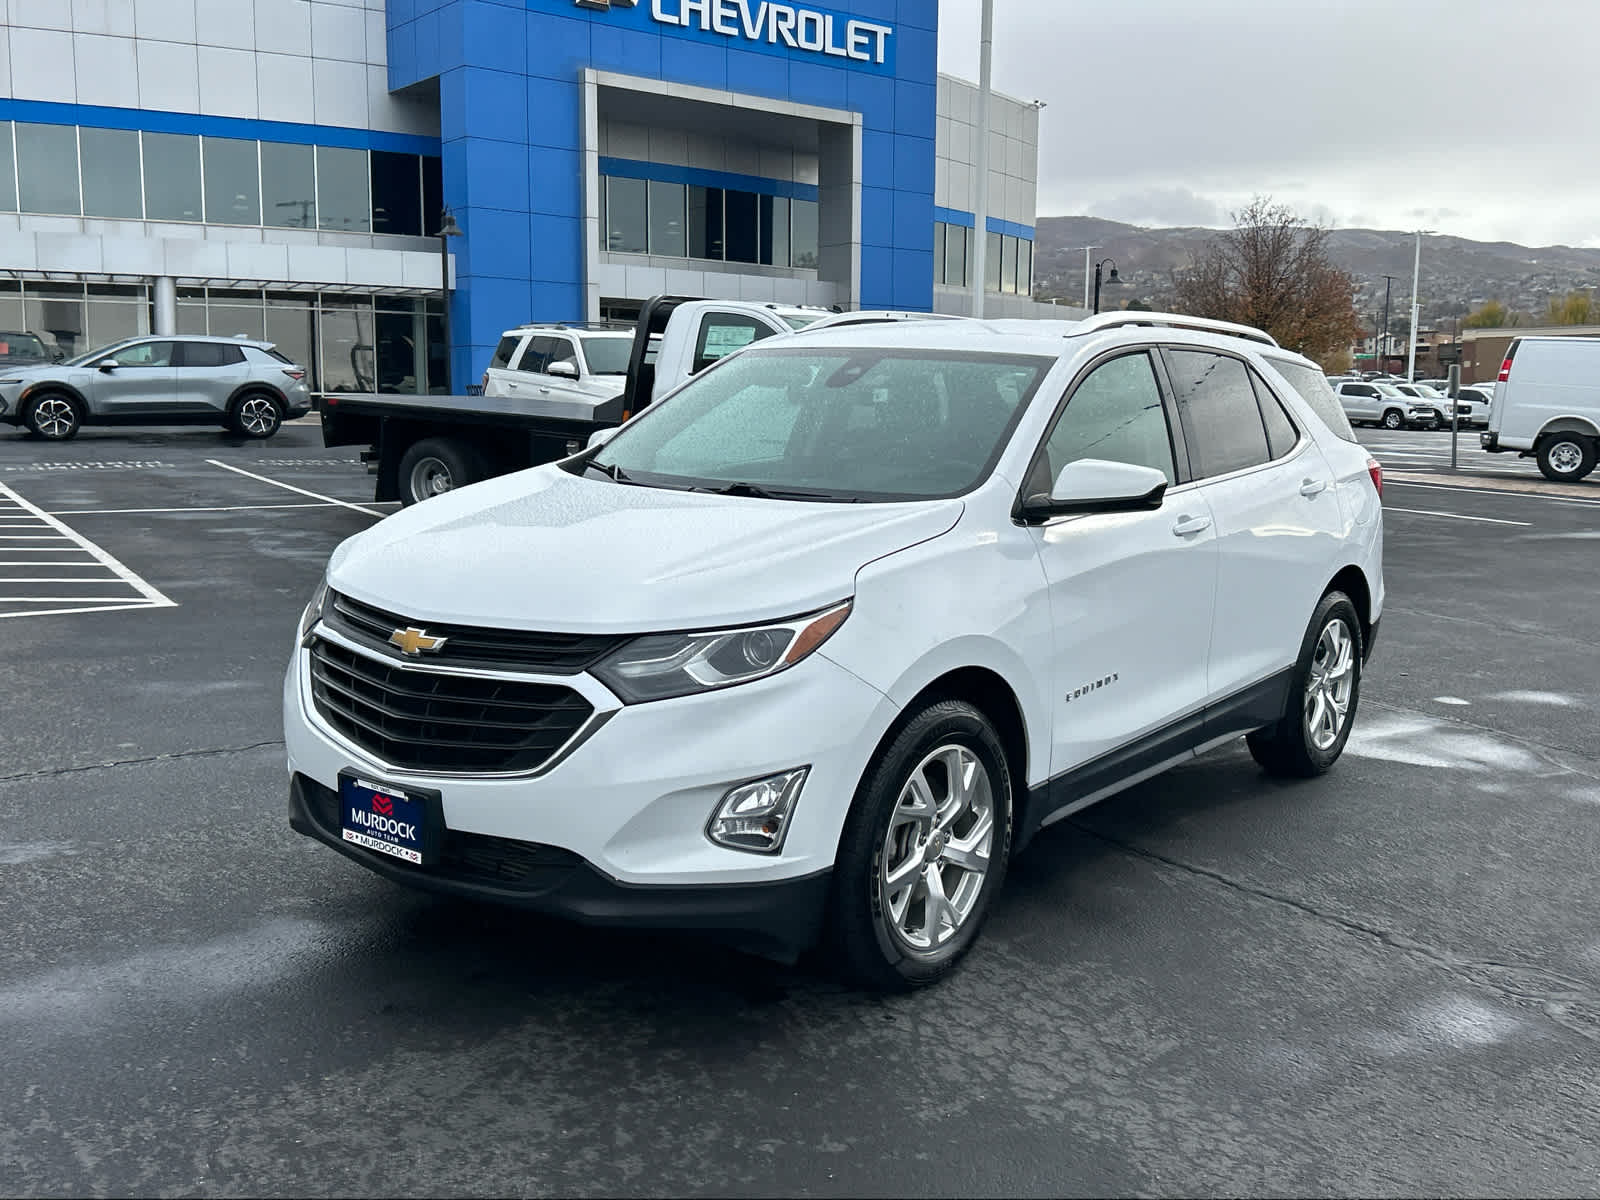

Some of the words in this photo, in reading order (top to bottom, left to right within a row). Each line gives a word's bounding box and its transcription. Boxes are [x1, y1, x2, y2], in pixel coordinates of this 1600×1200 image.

[652, 0, 892, 63] CHEVROLET
[351, 807, 416, 841] MURDOCK
[366, 829, 382, 838] AUTO
[384, 833, 399, 843] TEAM
[359, 836, 404, 857] MURDOCK
